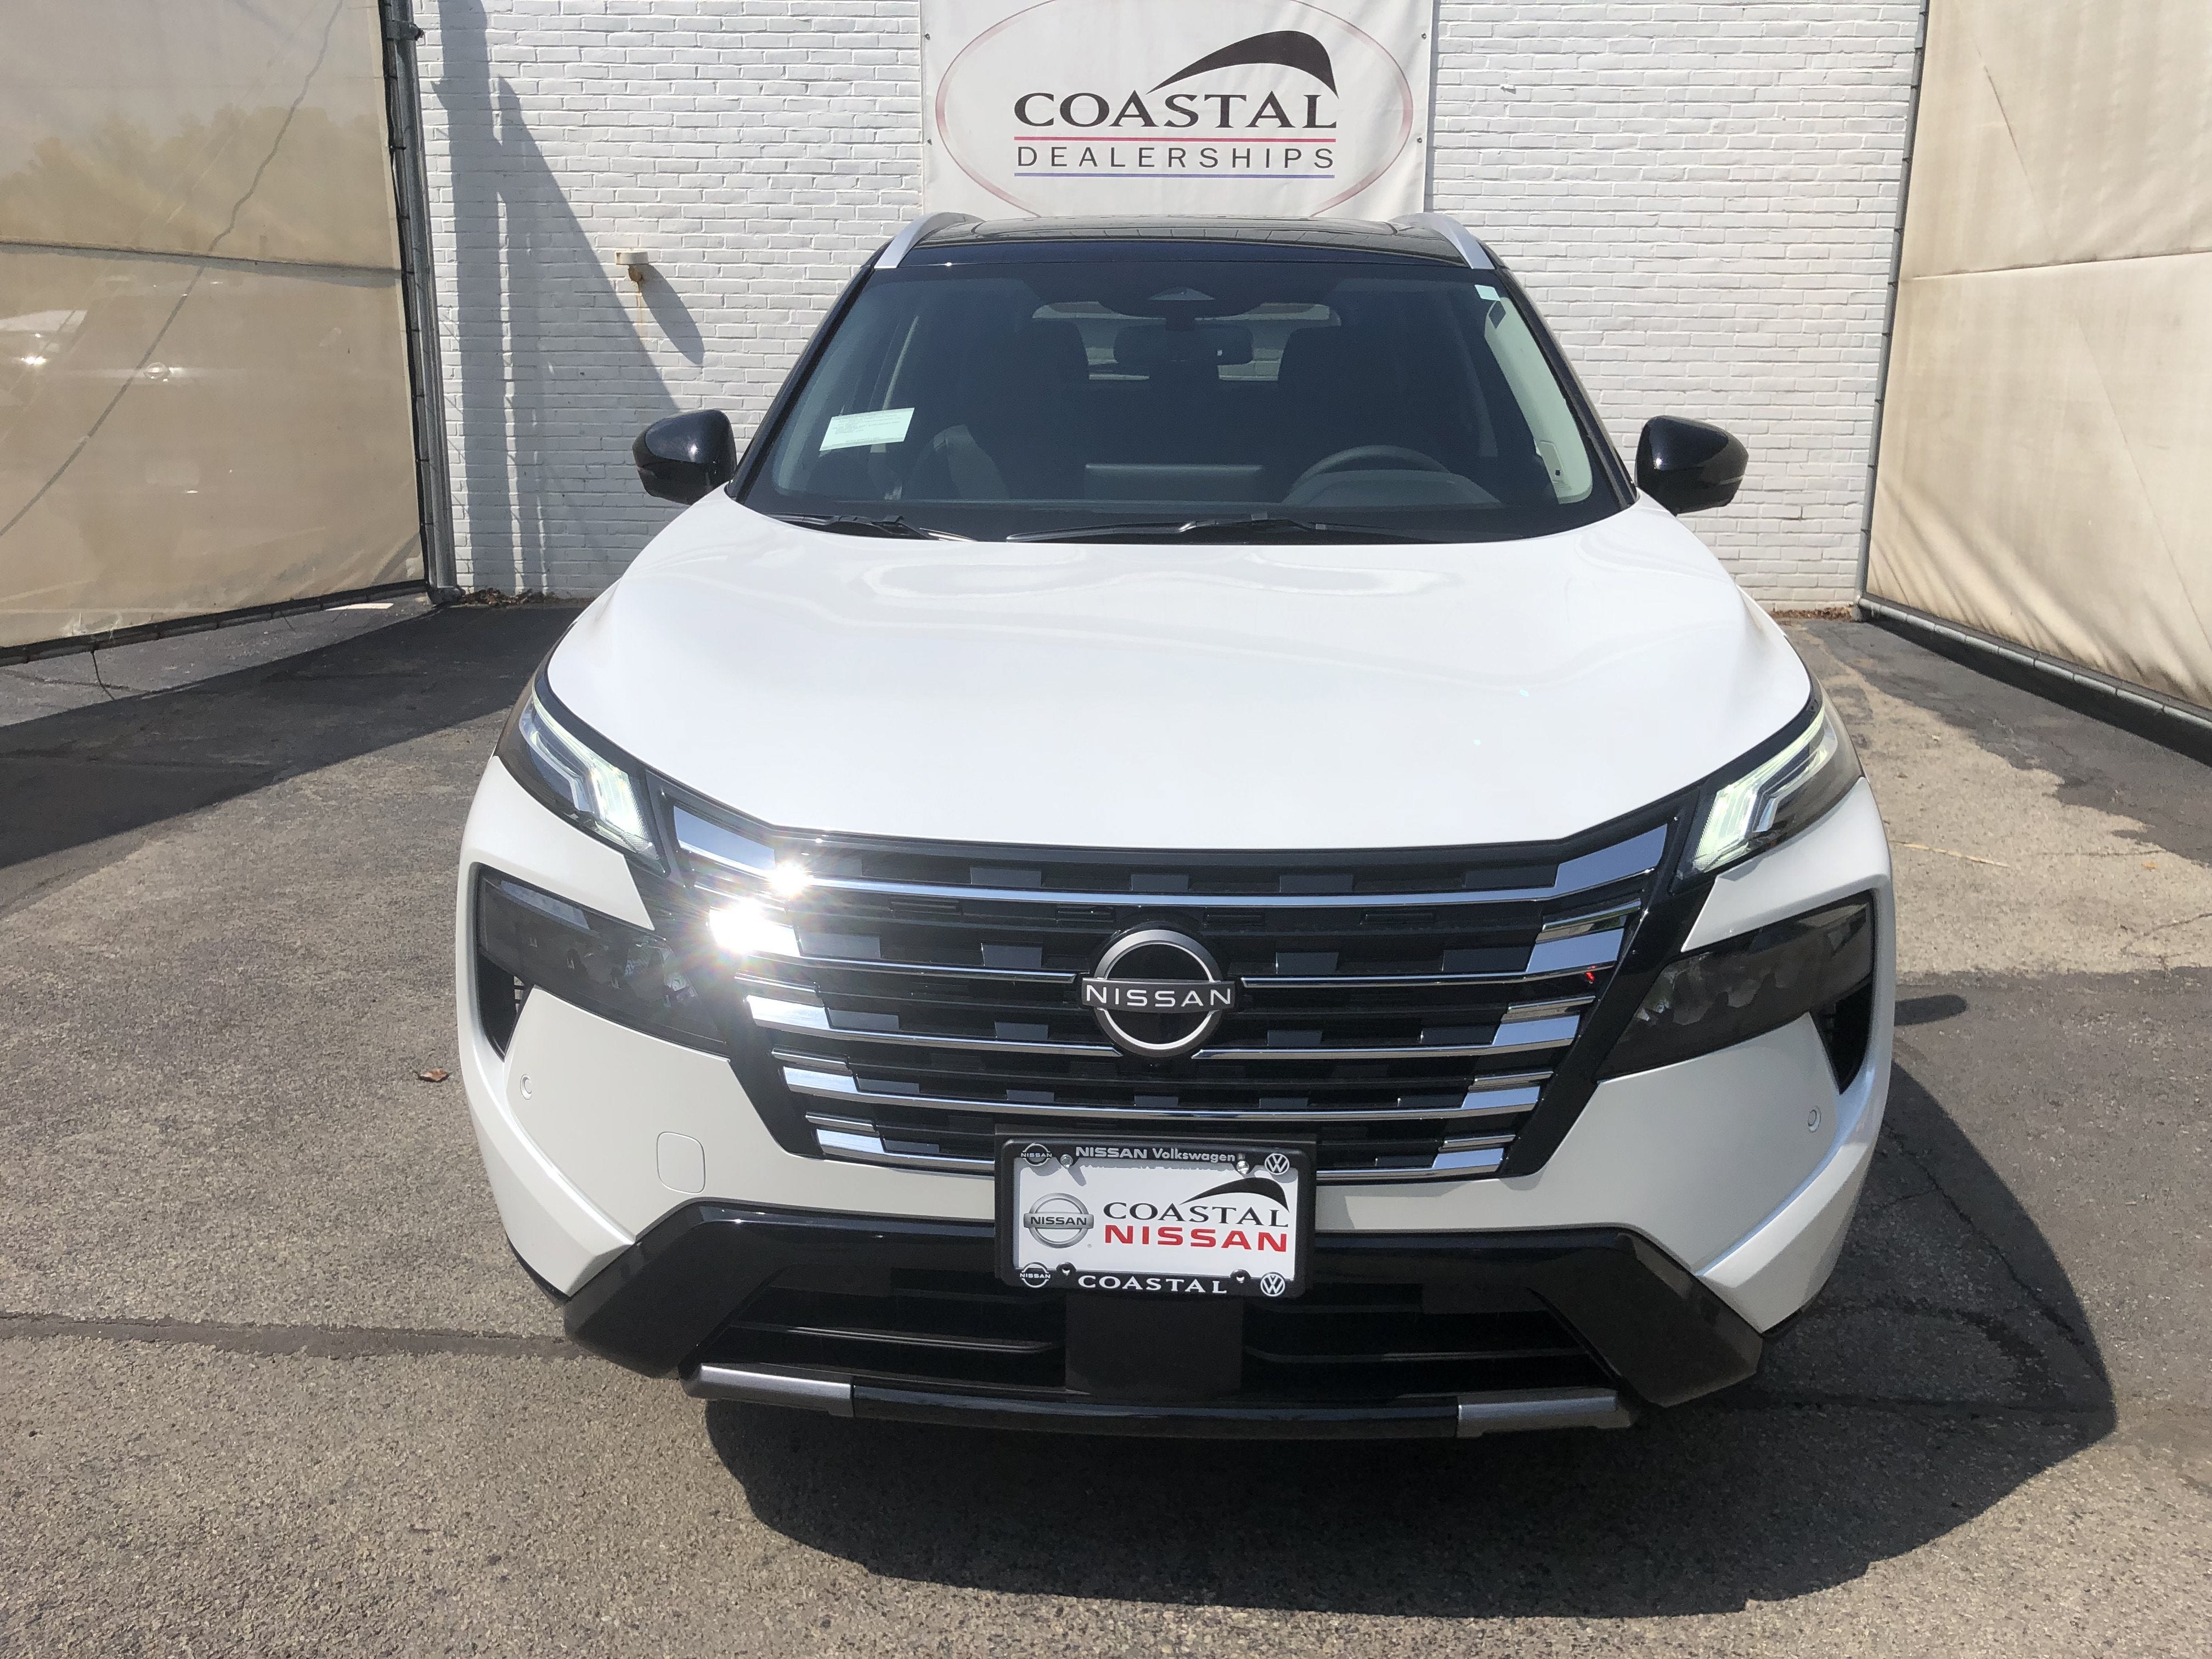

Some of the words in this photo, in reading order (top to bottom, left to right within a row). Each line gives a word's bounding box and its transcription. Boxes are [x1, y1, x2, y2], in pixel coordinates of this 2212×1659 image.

[1014, 90, 1337, 129] COASTAL
[1018, 146, 1334, 169] DEALERSHIPS
[1086, 985, 1231, 1007] NISSAN
[1076, 1147, 1147, 1159] NISSAN
[1152, 1147, 1235, 1163] Volkswagen
[1031, 1216, 1087, 1225] NISSAN
[1103, 1201, 1289, 1227] COASTAL
[1104, 1224, 1286, 1252] NISSAN
[1078, 1275, 1227, 1294] COASTAL
